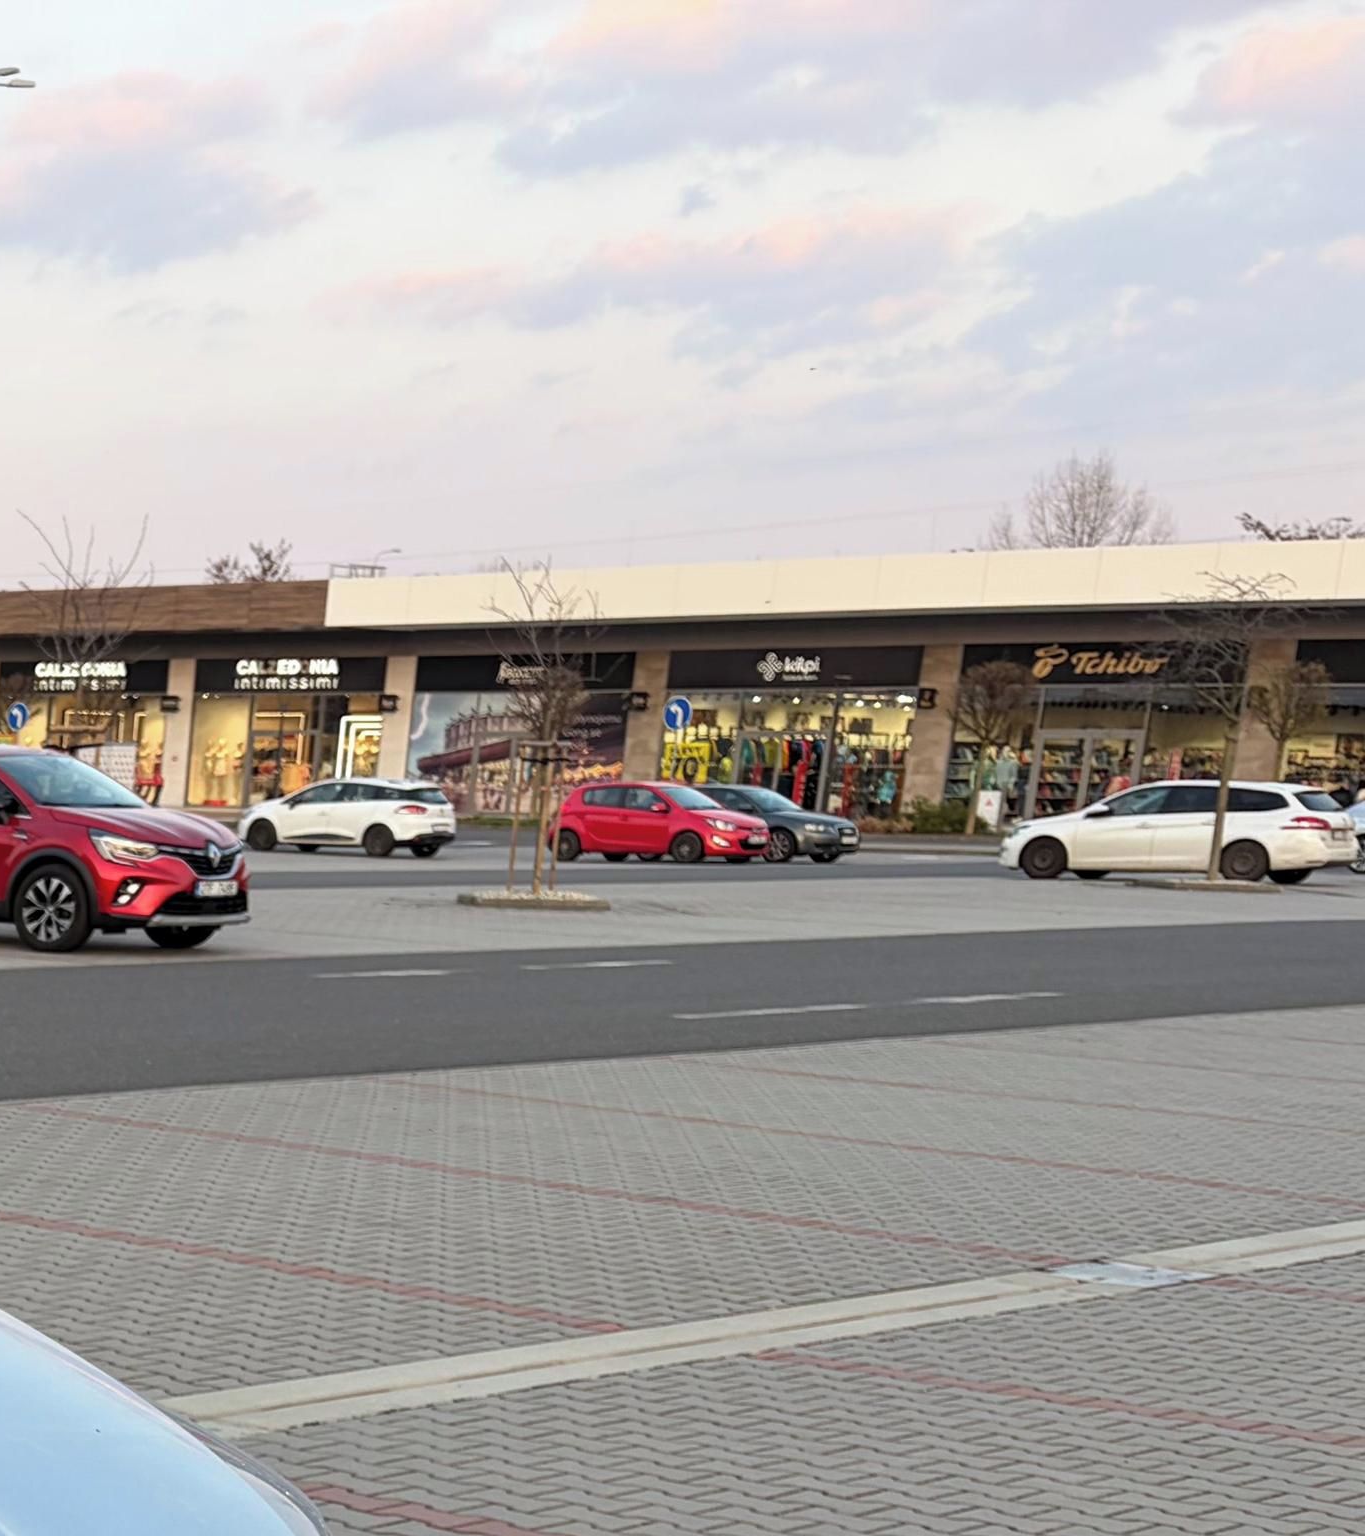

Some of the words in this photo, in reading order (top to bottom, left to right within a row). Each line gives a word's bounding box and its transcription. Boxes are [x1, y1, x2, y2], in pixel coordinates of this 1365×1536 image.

[235, 659, 340, 675] CALZEDONIA
[784, 656, 820, 675] kilpi
[1071, 651, 1169, 675] Tchibo
[234, 677, 340, 690] intimissimi
